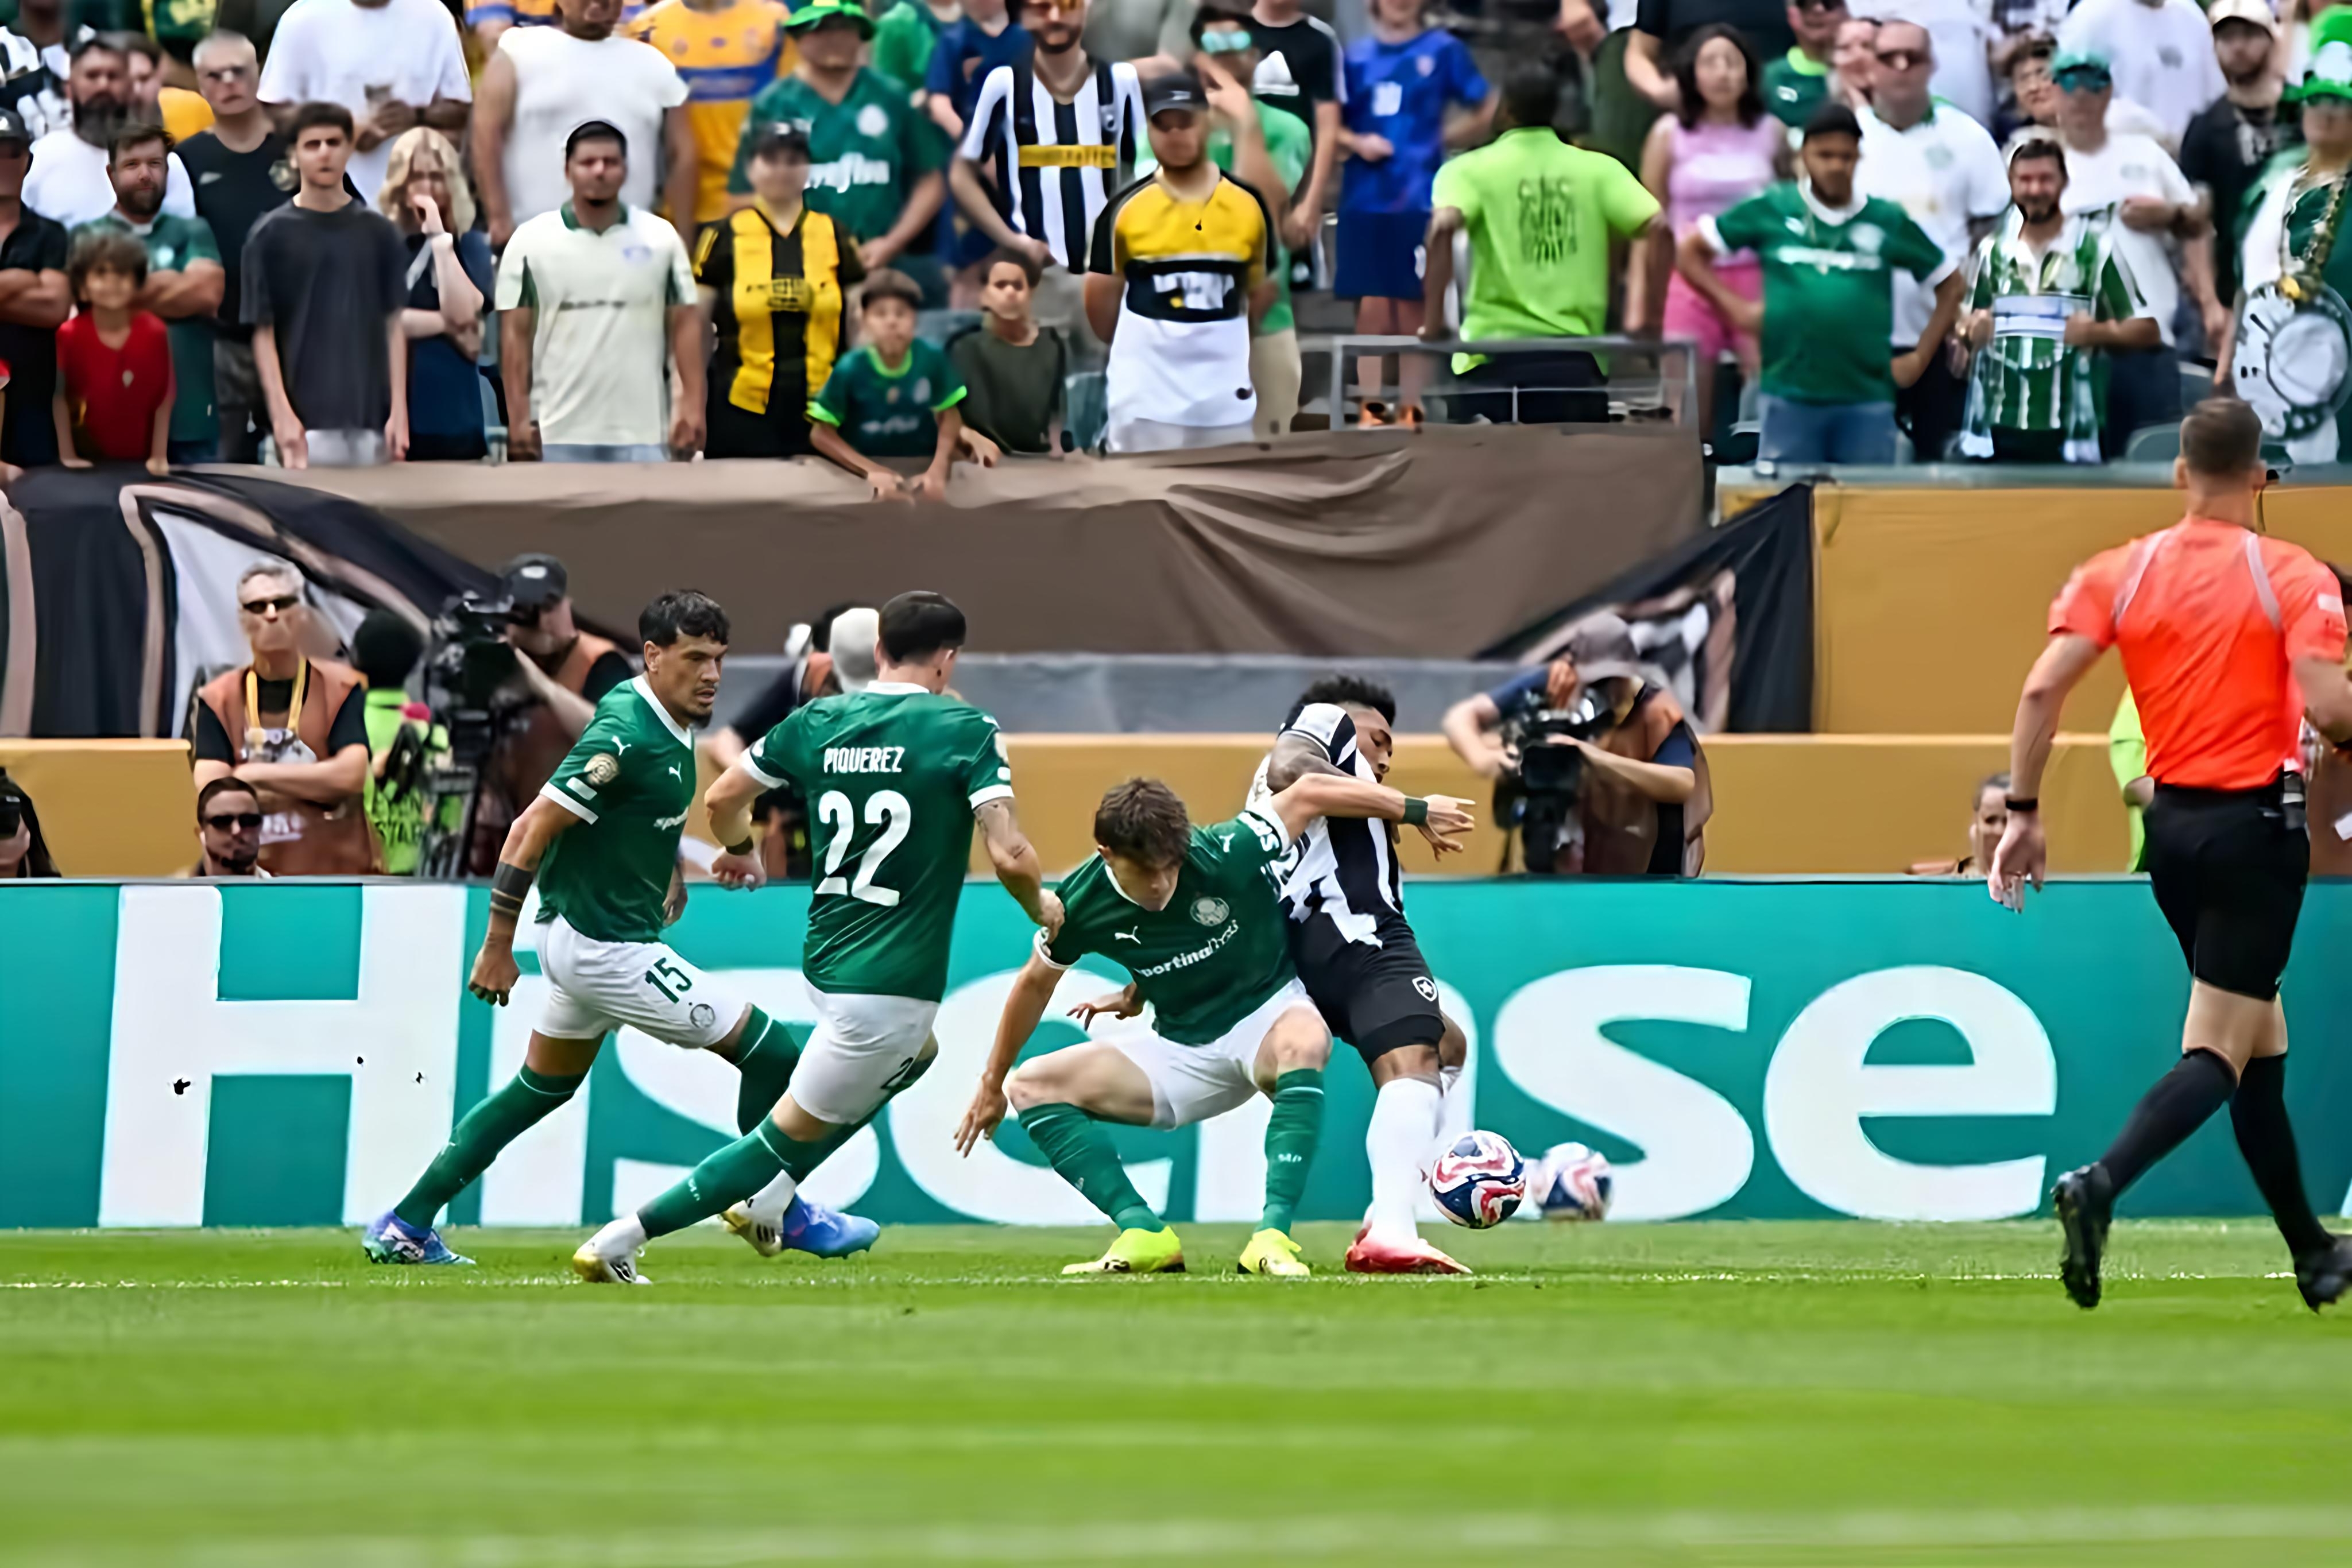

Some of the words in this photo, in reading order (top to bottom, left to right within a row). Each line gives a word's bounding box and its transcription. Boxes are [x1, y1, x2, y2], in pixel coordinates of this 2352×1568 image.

[823, 746, 906, 773] PIQUEREZ
[814, 789, 911, 907] 22
[645, 957, 693, 1004] 15
